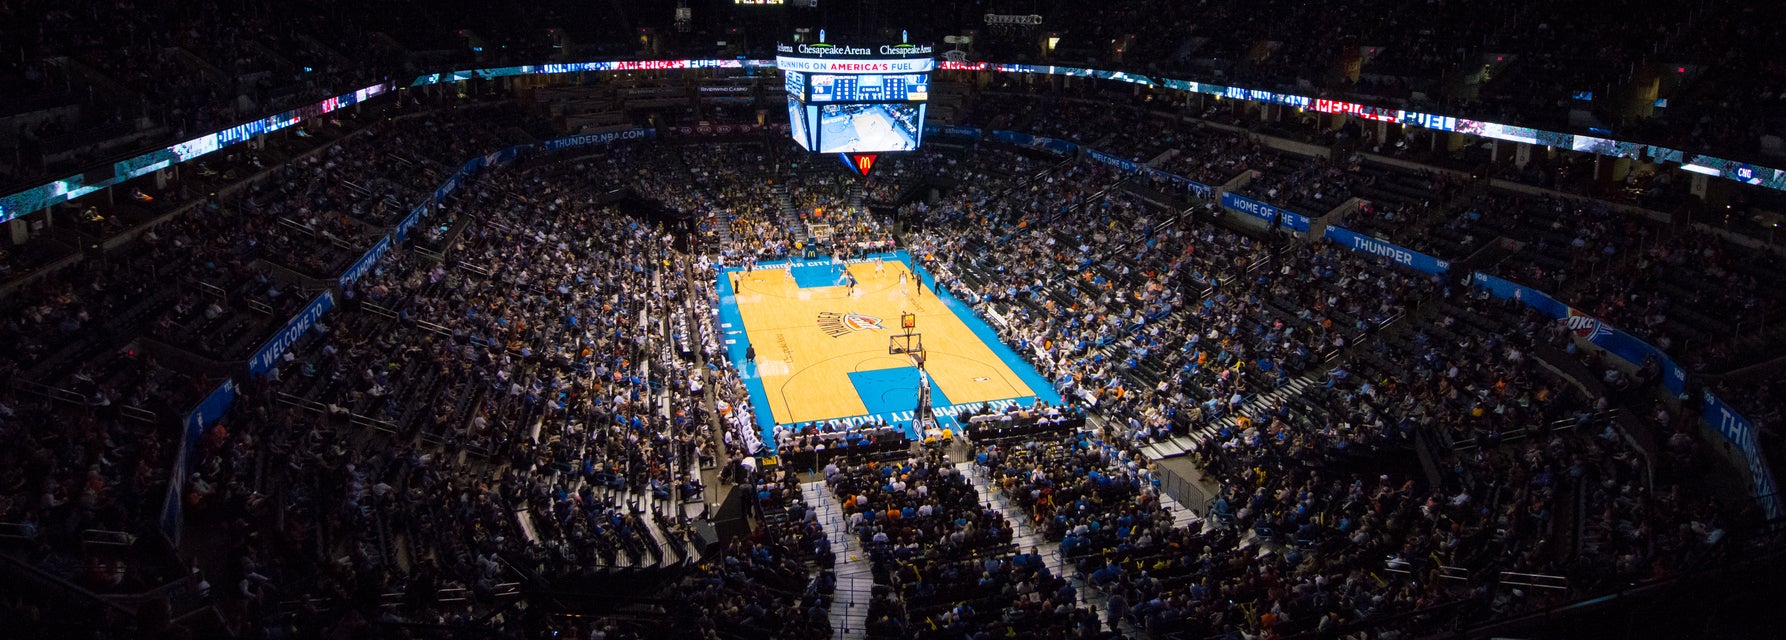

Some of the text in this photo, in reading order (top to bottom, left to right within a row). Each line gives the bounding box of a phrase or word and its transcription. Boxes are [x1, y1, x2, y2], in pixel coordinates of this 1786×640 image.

[799, 44, 871, 57] Chesapeake Arena
[880, 45, 920, 58] Chesapeake
[617, 60, 686, 71] AMERICA'S
[690, 59, 722, 69] FUEL
[780, 60, 913, 72] RUNNING ON AMERICA'S FUEL
[1308, 98, 1398, 123] AMERICA'S
[1402, 110, 1454, 135] FUEL
[554, 131, 645, 148] THUNDER.NBA.COM
[1092, 154, 1120, 168] WELCOME
[1121, 161, 1130, 170] TO
[1233, 197, 1294, 226] HOME OF HE
[1353, 236, 1413, 266] THUNDER
[1436, 260, 1449, 269] 107
[1475, 271, 1488, 282] 108
[1567, 316, 1595, 330] OKC
[262, 302, 322, 368] WELCOME TO
